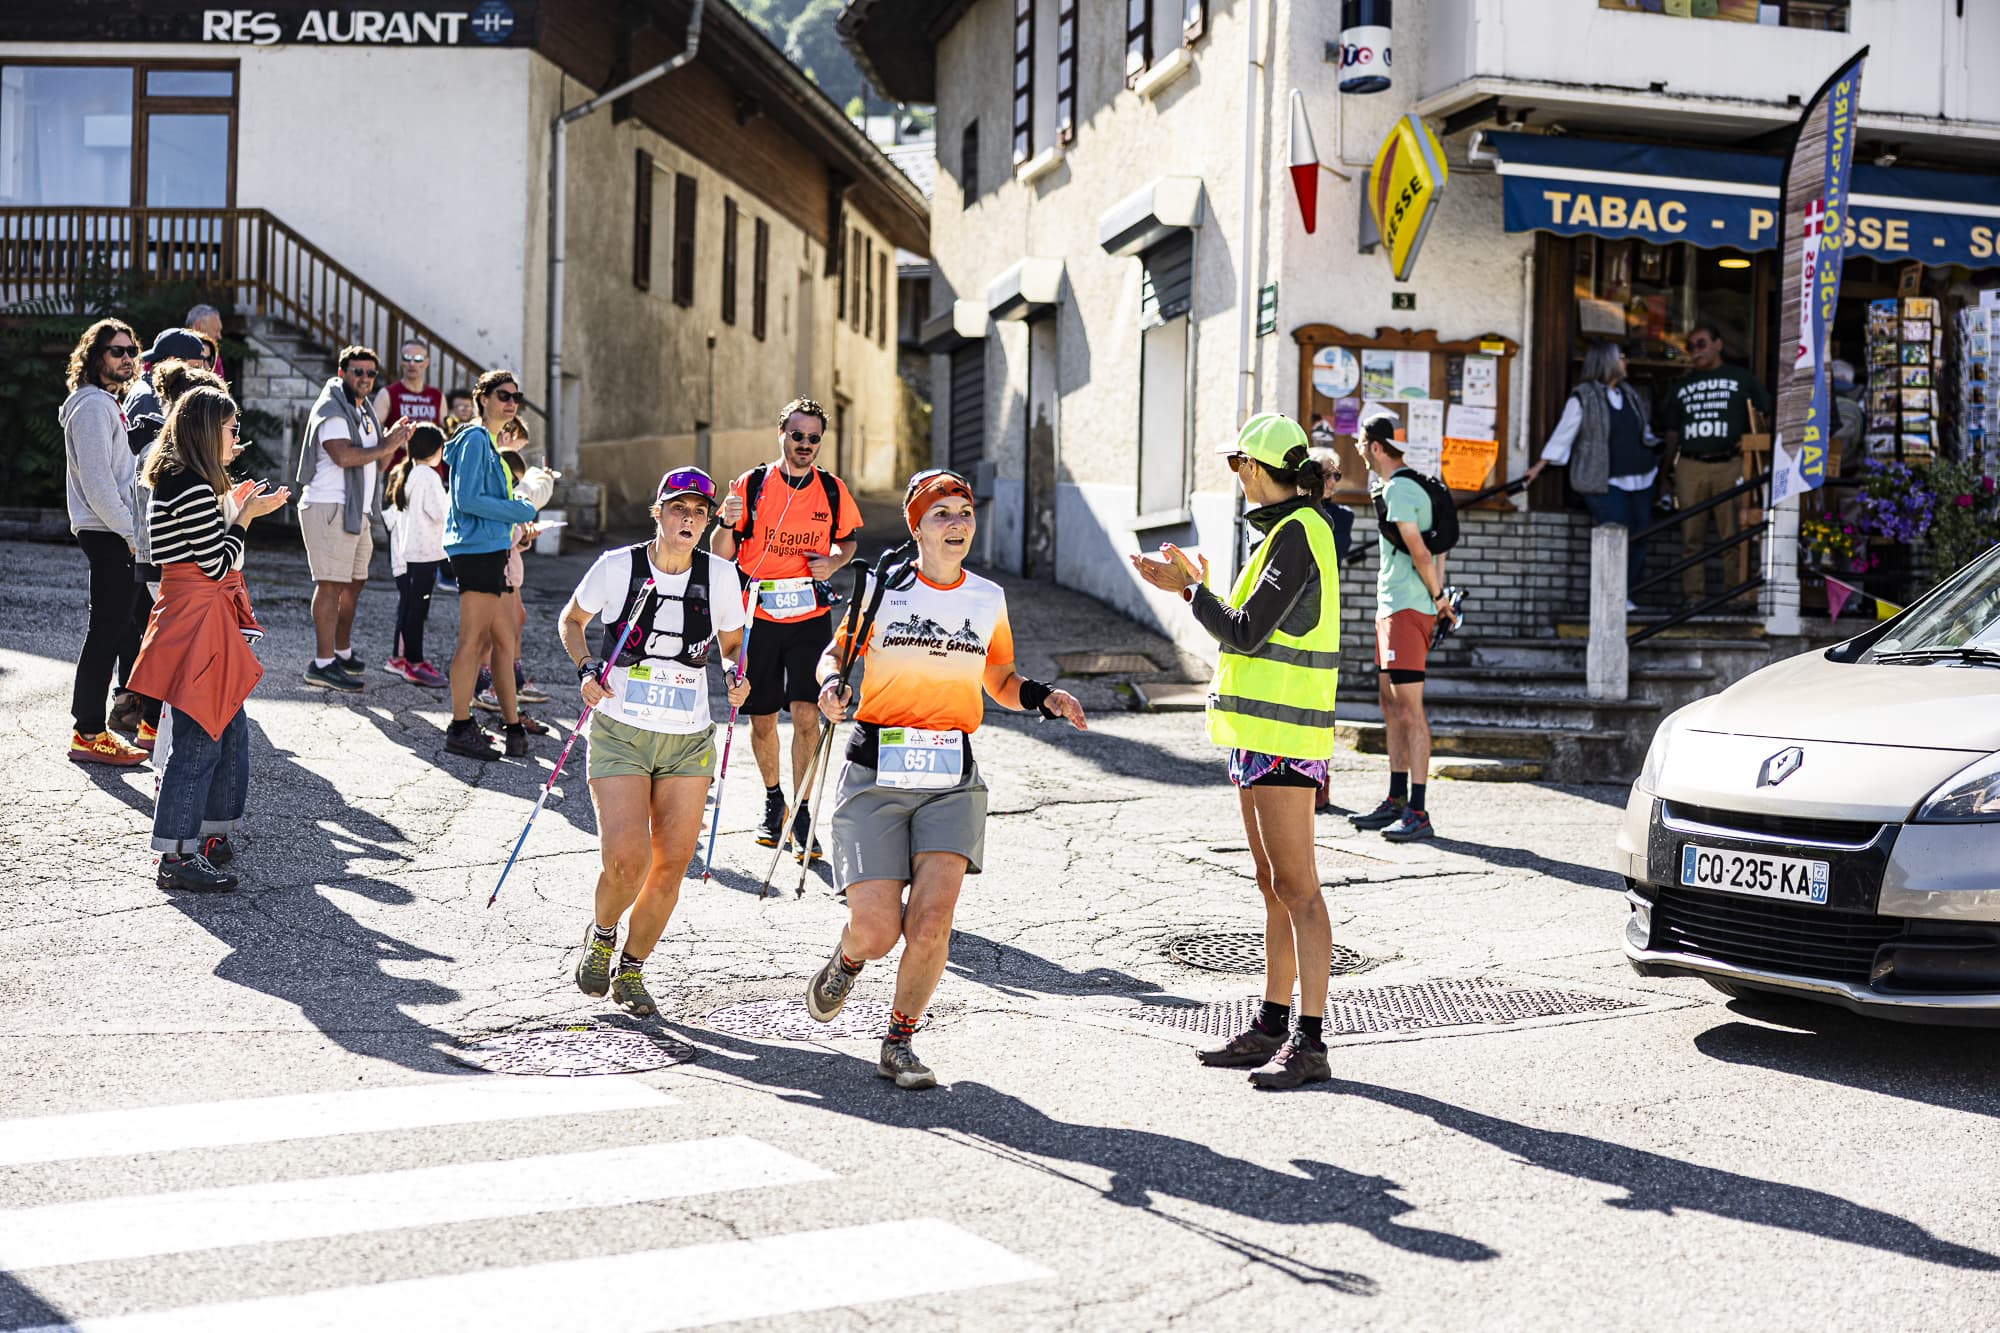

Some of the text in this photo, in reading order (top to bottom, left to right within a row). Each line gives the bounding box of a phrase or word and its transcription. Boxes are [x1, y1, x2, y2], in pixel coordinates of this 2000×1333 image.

[297, 10, 468, 43] AURANT
[1544, 191, 1687, 233] TABAC
[1749, 208, 1909, 251] PSSE
[1399, 296, 1409, 309] 3
[1678, 379, 1739, 399] AVOUEZ
[775, 593, 799, 608] 649
[882, 635, 943, 649] ENDURANCE
[647, 685, 676, 707] 511
[93, 742, 117, 755] HOKA
[904, 749, 936, 771] 651
[1697, 853, 1810, 896] CQ-235-KA
[1812, 883, 1826, 899] 37
